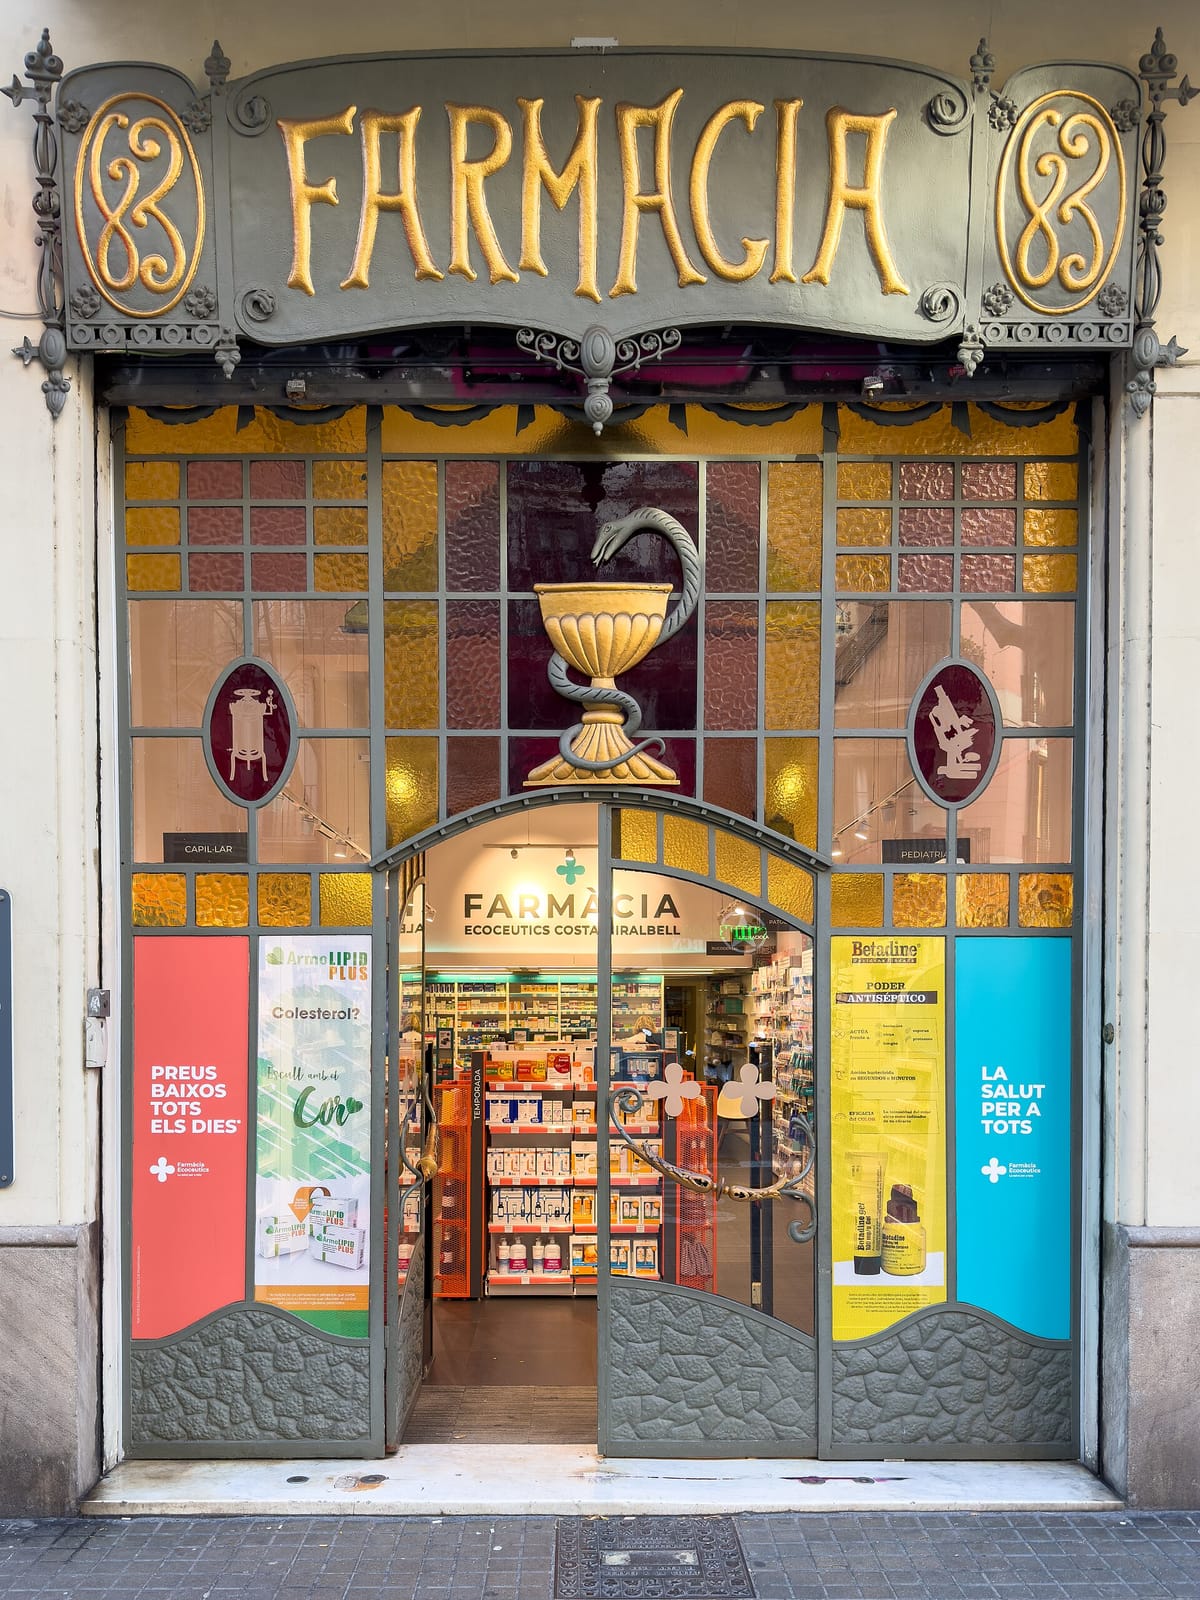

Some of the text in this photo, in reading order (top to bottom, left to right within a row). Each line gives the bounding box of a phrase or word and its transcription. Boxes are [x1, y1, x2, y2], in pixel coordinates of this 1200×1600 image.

[277, 88, 911, 302] FARMACIA
[464, 925, 681, 936] ECOCEUTICS COSTA IRALBELL
[287, 951, 368, 966] ArmoLIPID
[329, 966, 368, 981] PLUS
[866, 982, 906, 991] PODER
[847, 992, 926, 1003] ANTISÉPTICO
[272, 1007, 360, 1020] Colesterol?
[151, 1066, 217, 1081] PREUS
[981, 1066, 1008, 1081] LA
[151, 1083, 227, 1098] BAIXOS
[473, 1068, 481, 1121] TEMPORADA
[981, 1084, 1046, 1099] SALUT
[150, 1101, 202, 1116] TOTS
[981, 1102, 1041, 1117] PER A
[151, 1119, 187, 1134] ELS
[980, 1119, 1033, 1134] TOTS
[326, 1216, 344, 1226] PLUS
[337, 1244, 354, 1255] PLUS
